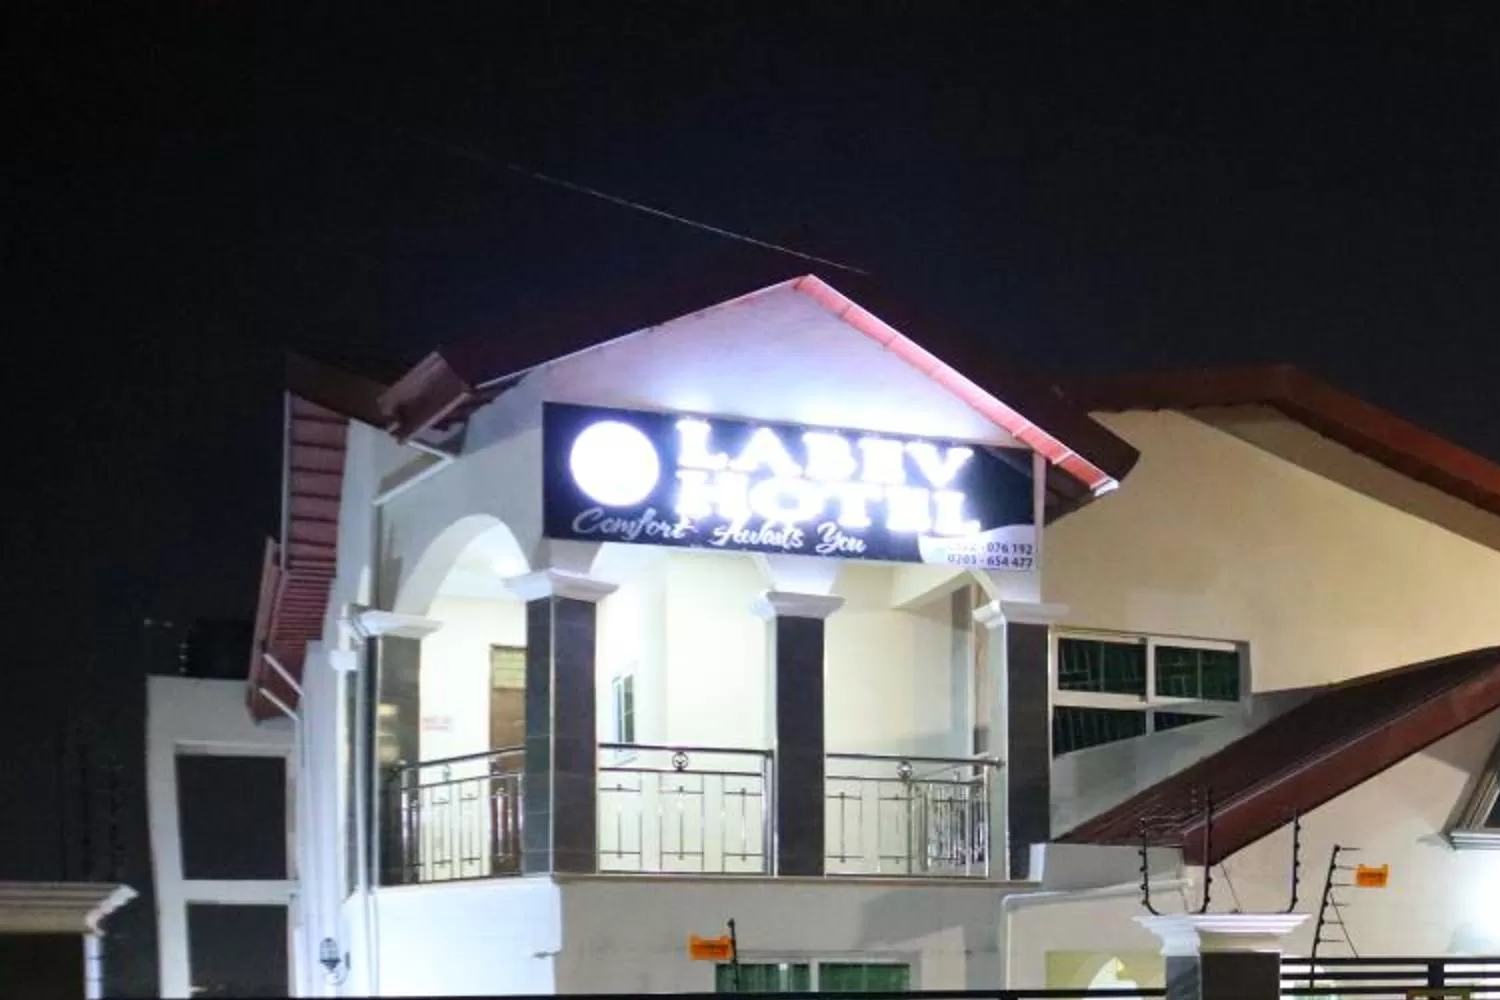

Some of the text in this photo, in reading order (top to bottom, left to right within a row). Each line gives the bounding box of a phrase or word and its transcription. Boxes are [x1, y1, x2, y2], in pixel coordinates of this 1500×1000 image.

[571, 506, 698, 542] Comfort
[814, 520, 867, 555] You
[674, 468, 982, 537] HOTEL
